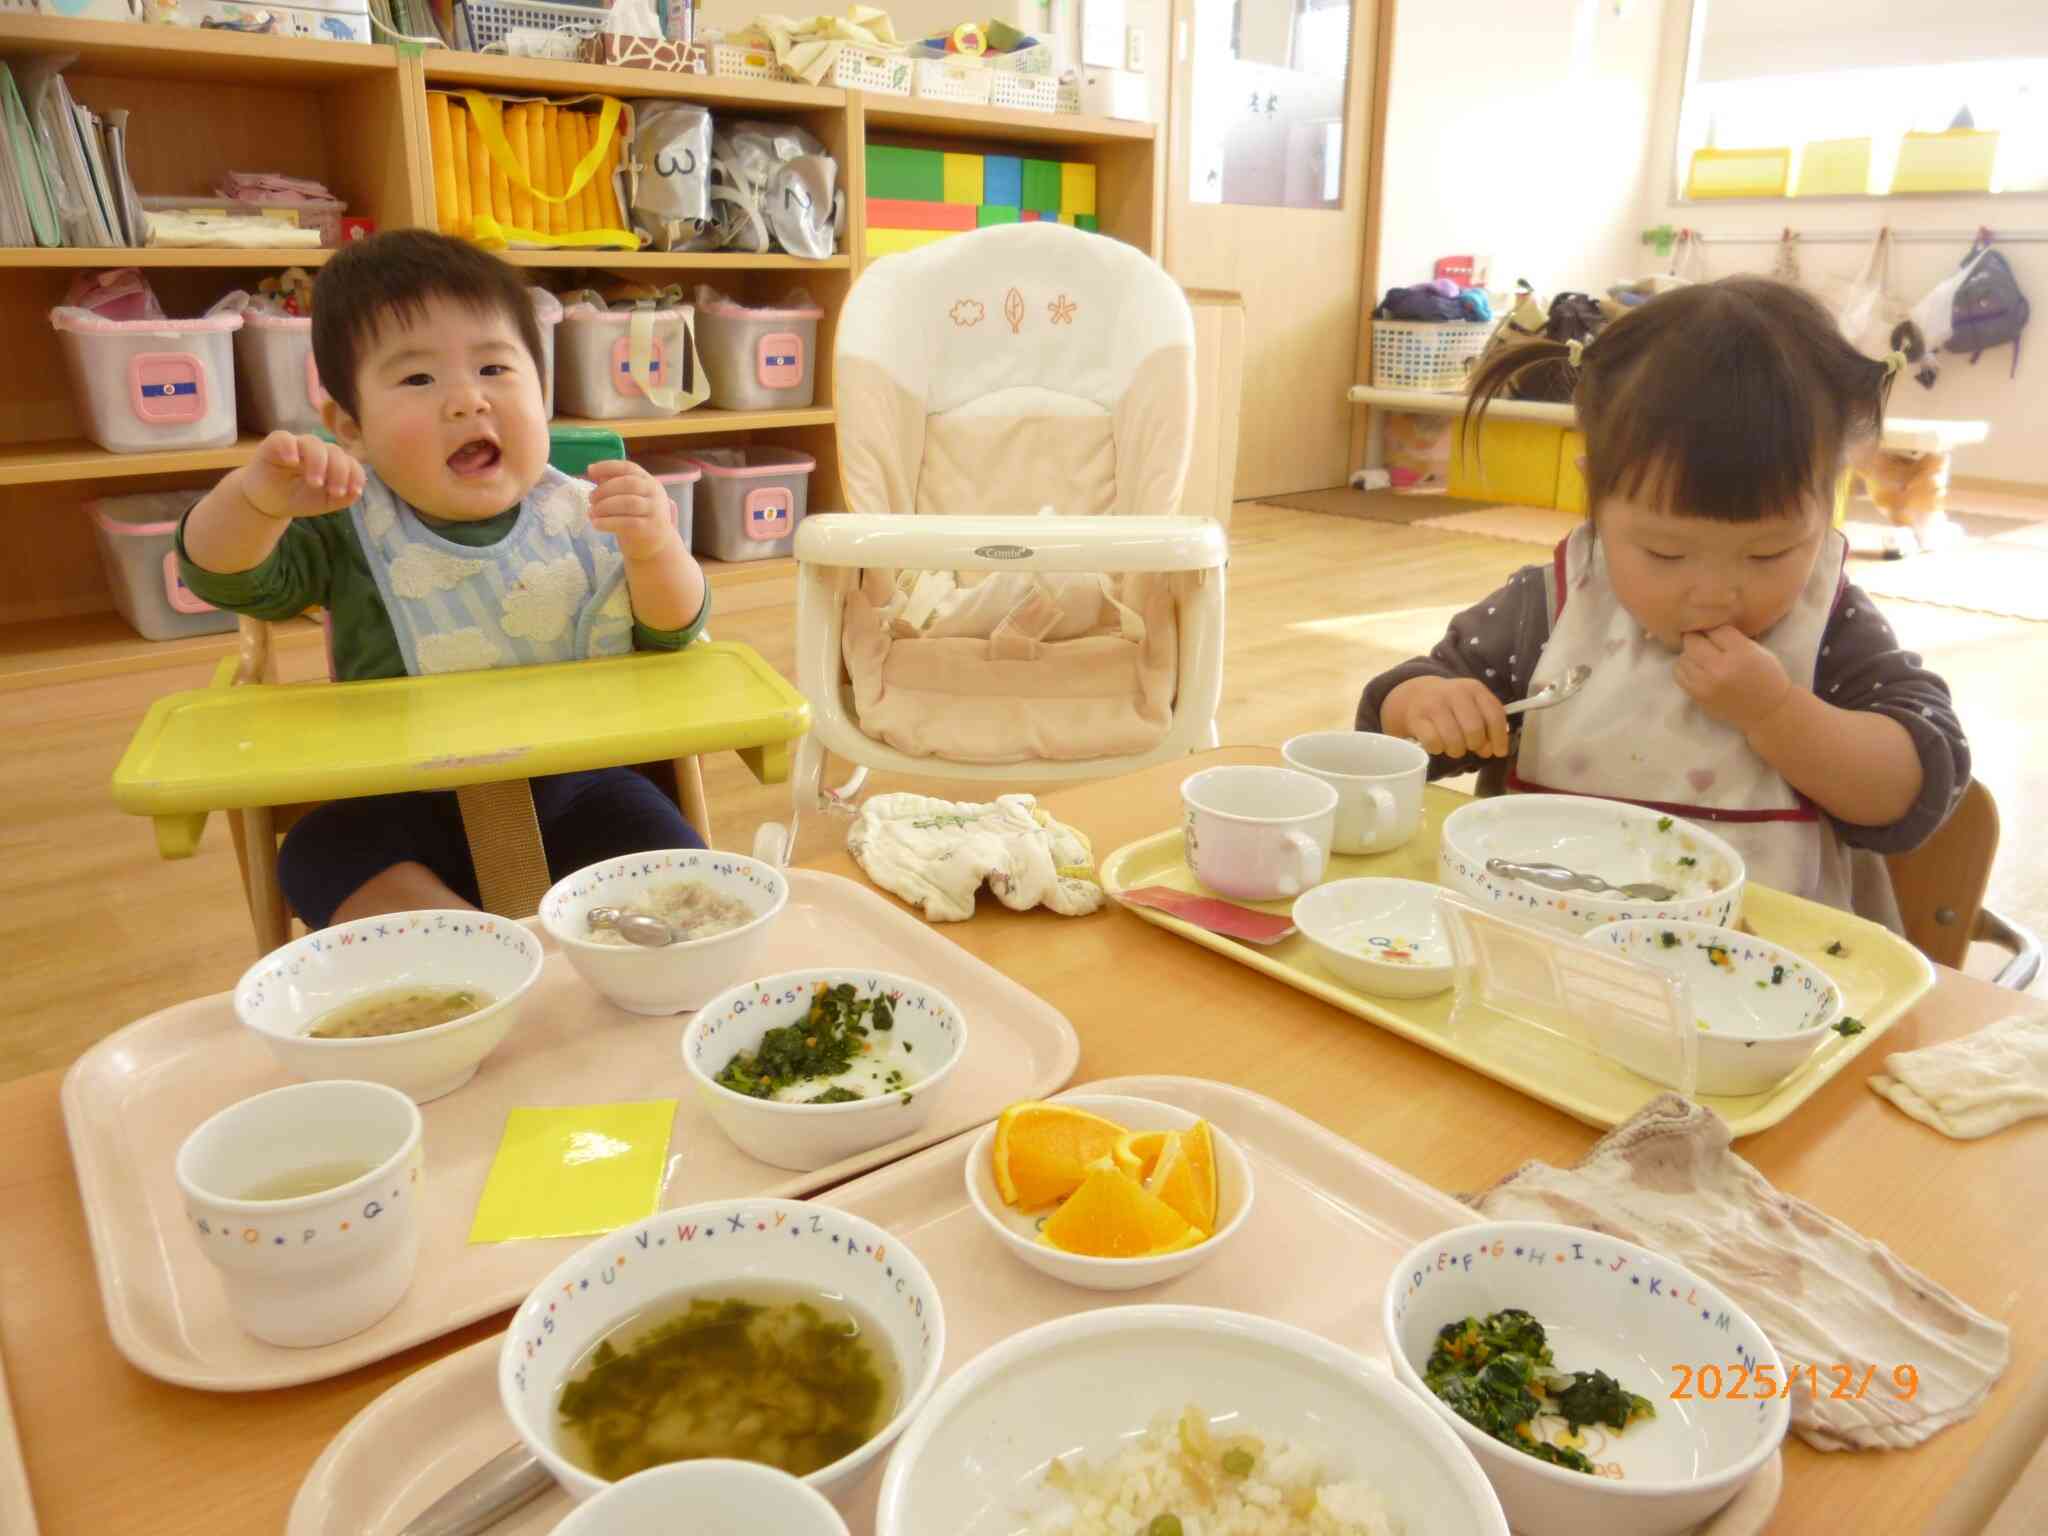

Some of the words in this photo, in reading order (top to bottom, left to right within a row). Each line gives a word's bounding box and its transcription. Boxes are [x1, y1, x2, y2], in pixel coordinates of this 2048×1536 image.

[655, 148, 696, 177] 3
[784, 188, 812, 210] 2
[642, 863, 653, 876] K
[340, 933, 357, 946] W
[734, 1000, 747, 1015] Q
[760, 993, 771, 1007] R
[785, 991, 796, 1003] S
[867, 980, 878, 993] V
[917, 997, 926, 1010] X
[1804, 977, 1813, 990] D
[244, 1229, 259, 1243] O
[303, 1229, 316, 1244] P
[363, 1201, 384, 1220] Q
[602, 1266, 615, 1285] U
[635, 1232, 650, 1250] V
[677, 1225, 698, 1242] W
[727, 1213, 746, 1232] X
[773, 1211, 788, 1228] Y
[809, 1215, 824, 1233] Z
[846, 1237, 859, 1255] A
[873, 1244, 886, 1263] B
[895, 1278, 905, 1294] C
[1413, 1271, 1424, 1289] D
[1437, 1252, 1449, 1271] E
[1463, 1253, 1473, 1272] F
[1491, 1238, 1505, 1258] G
[1527, 1248, 1547, 1265] H
[1571, 1243, 1585, 1260] I
[1609, 1257, 1628, 1273] J
[1648, 1277, 1662, 1296] K
[1687, 1289, 1698, 1306] L
[1714, 1312, 1732, 1332] M
